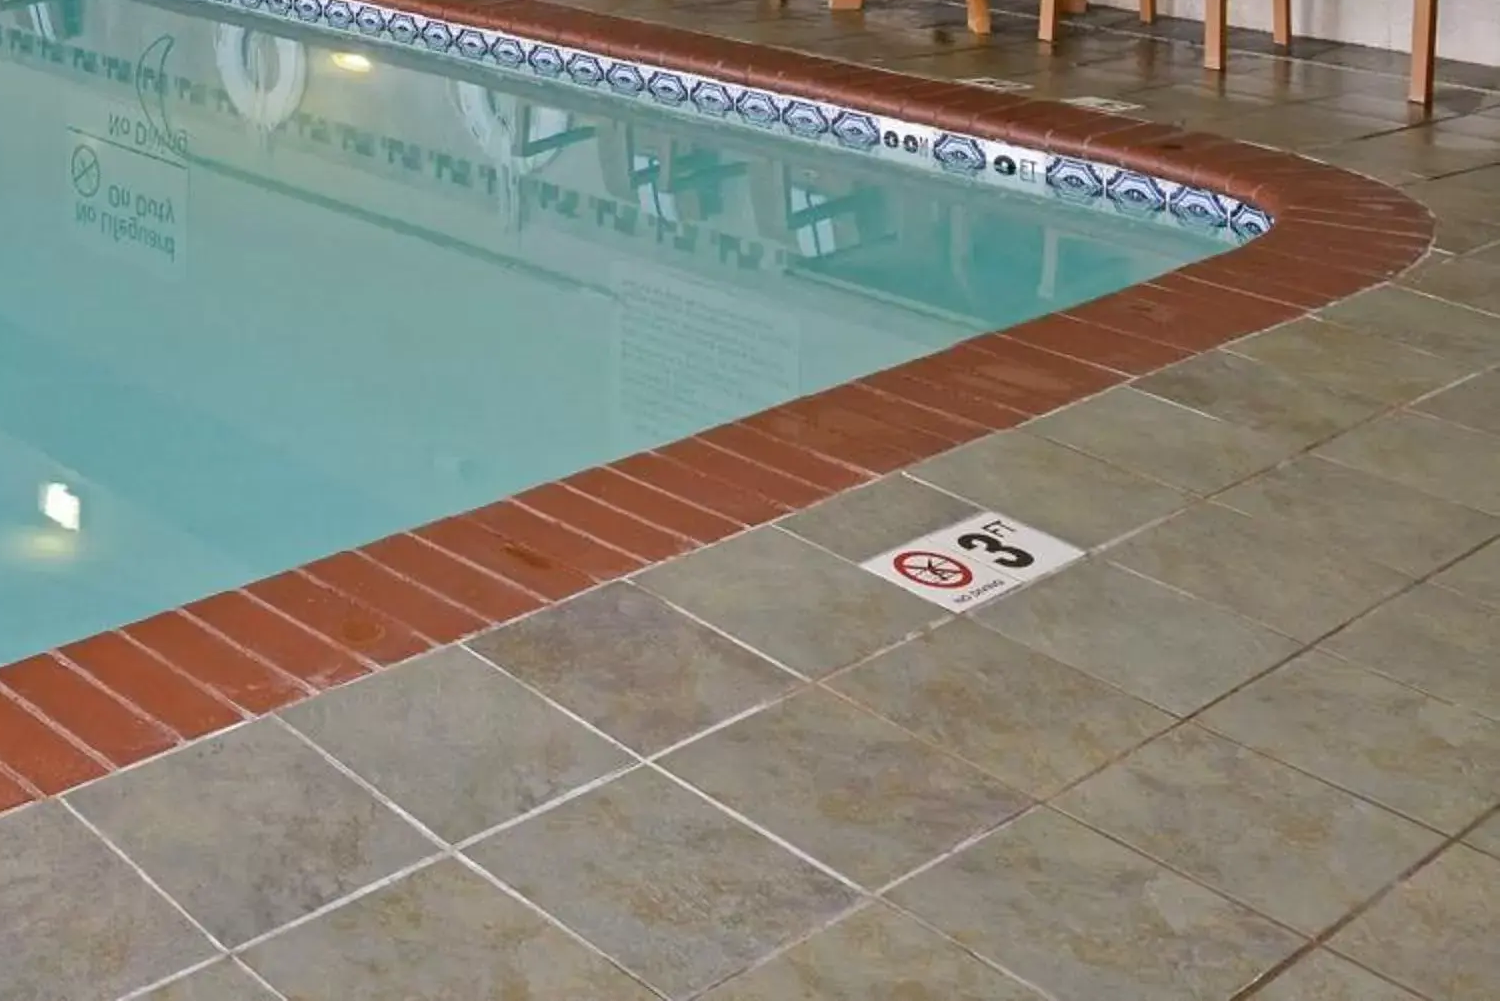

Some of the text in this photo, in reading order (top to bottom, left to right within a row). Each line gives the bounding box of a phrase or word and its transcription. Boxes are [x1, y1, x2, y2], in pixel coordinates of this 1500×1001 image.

[957, 520, 1035, 568] 3 FT
[953, 578, 1006, 604] NO DIVING
